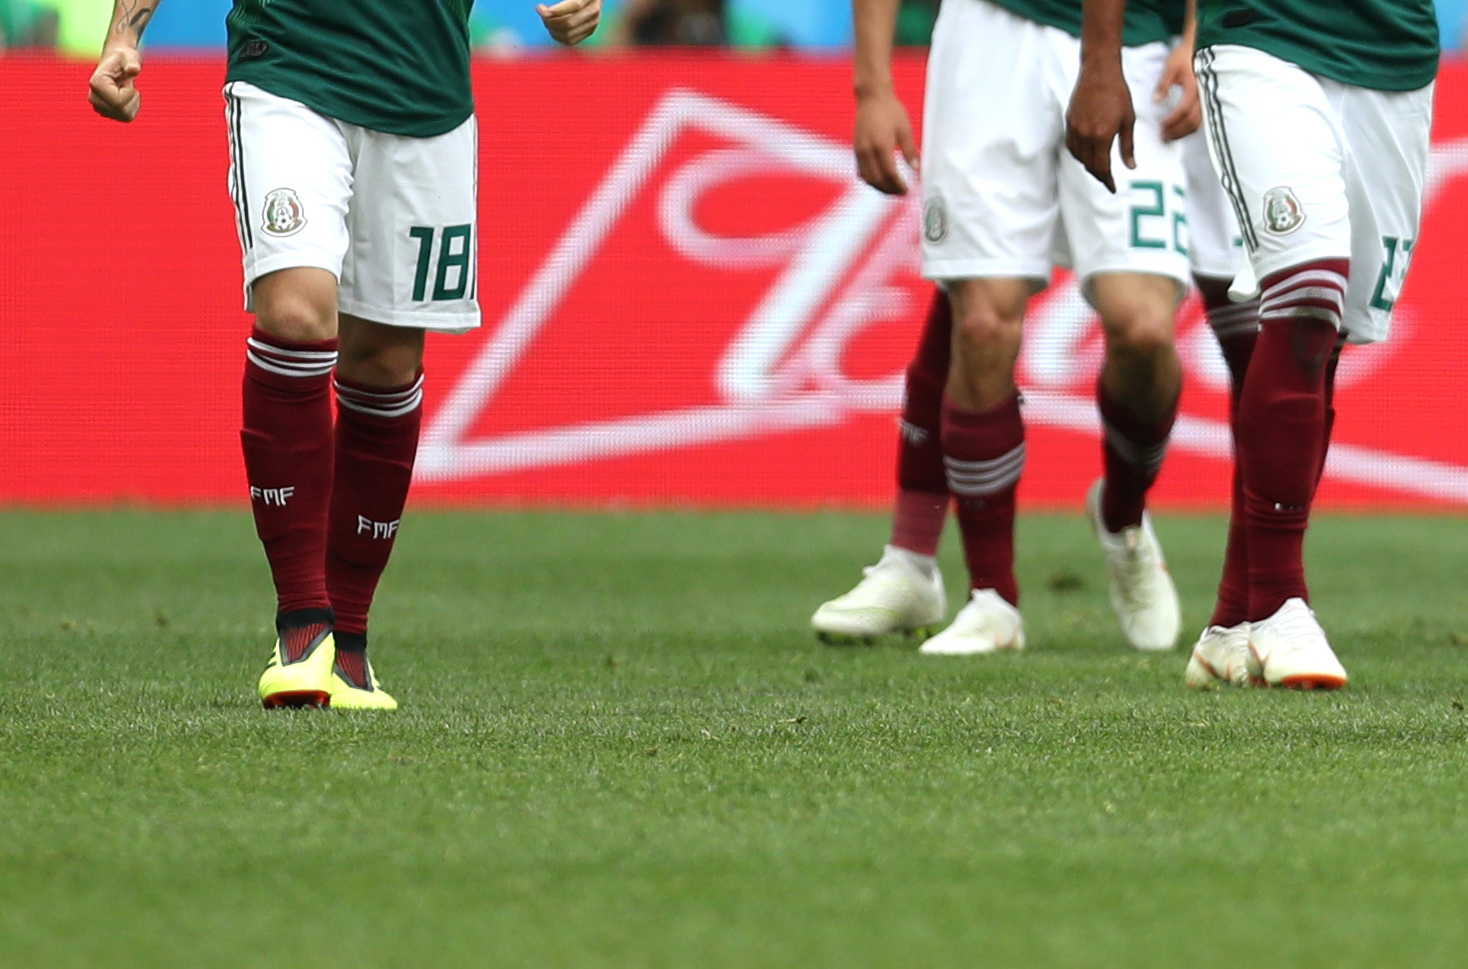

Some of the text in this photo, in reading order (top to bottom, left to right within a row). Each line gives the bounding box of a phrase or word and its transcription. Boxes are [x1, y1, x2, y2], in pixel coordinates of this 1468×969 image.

[409, 223, 472, 302] 18
[250, 485, 296, 507] FMF
[357, 514, 400, 540] FMF
